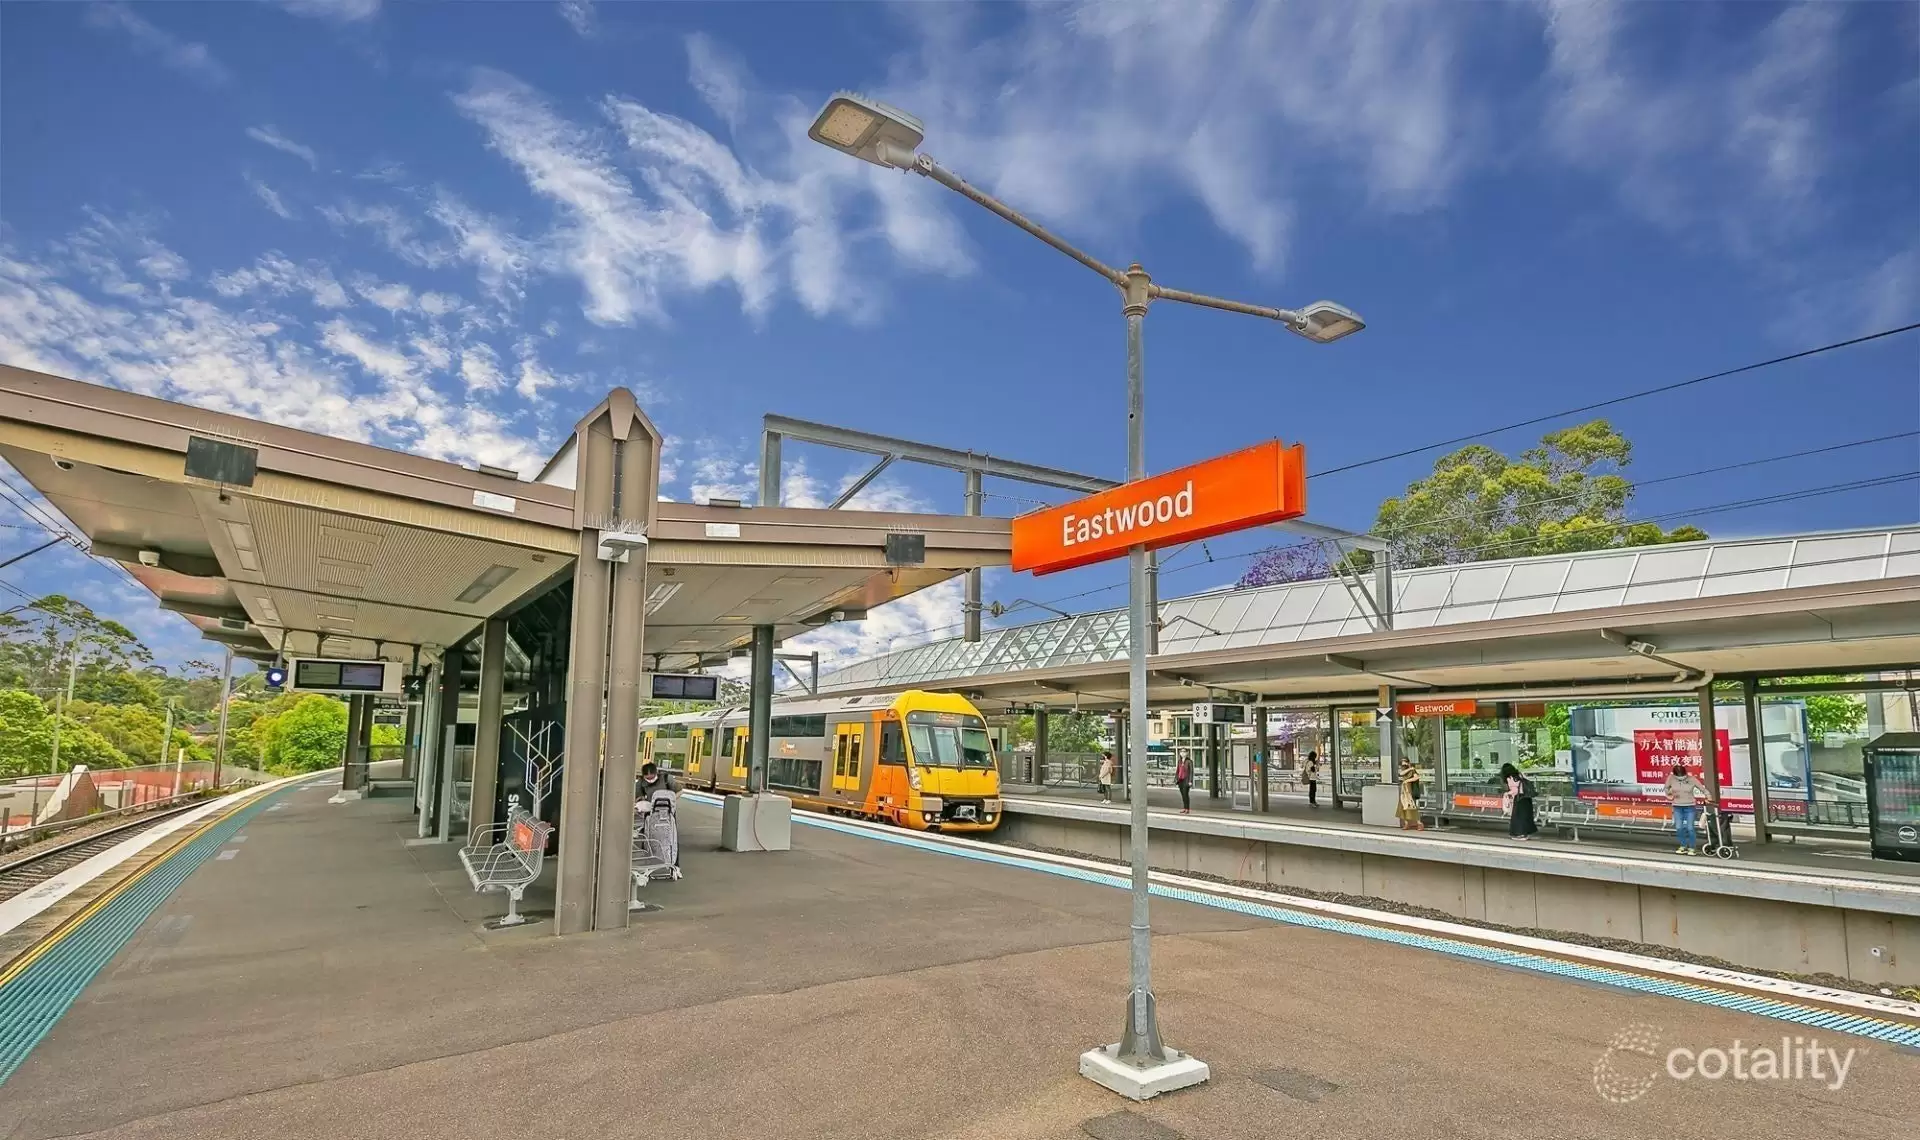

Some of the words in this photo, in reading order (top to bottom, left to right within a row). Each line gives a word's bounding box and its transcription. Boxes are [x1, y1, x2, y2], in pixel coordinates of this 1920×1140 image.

[1063, 480, 1193, 547] Eastwood
[411, 680, 420, 690] 4
[1414, 703, 1455, 713] Eastwood
[1651, 710, 1686, 719] FOTILE
[1640, 738, 1723, 752] 方太智能油
[1650, 754, 1703, 767] 科技改变厨
[1469, 797, 1498, 806] Eastwood
[1615, 807, 1653, 816] Eastwood
